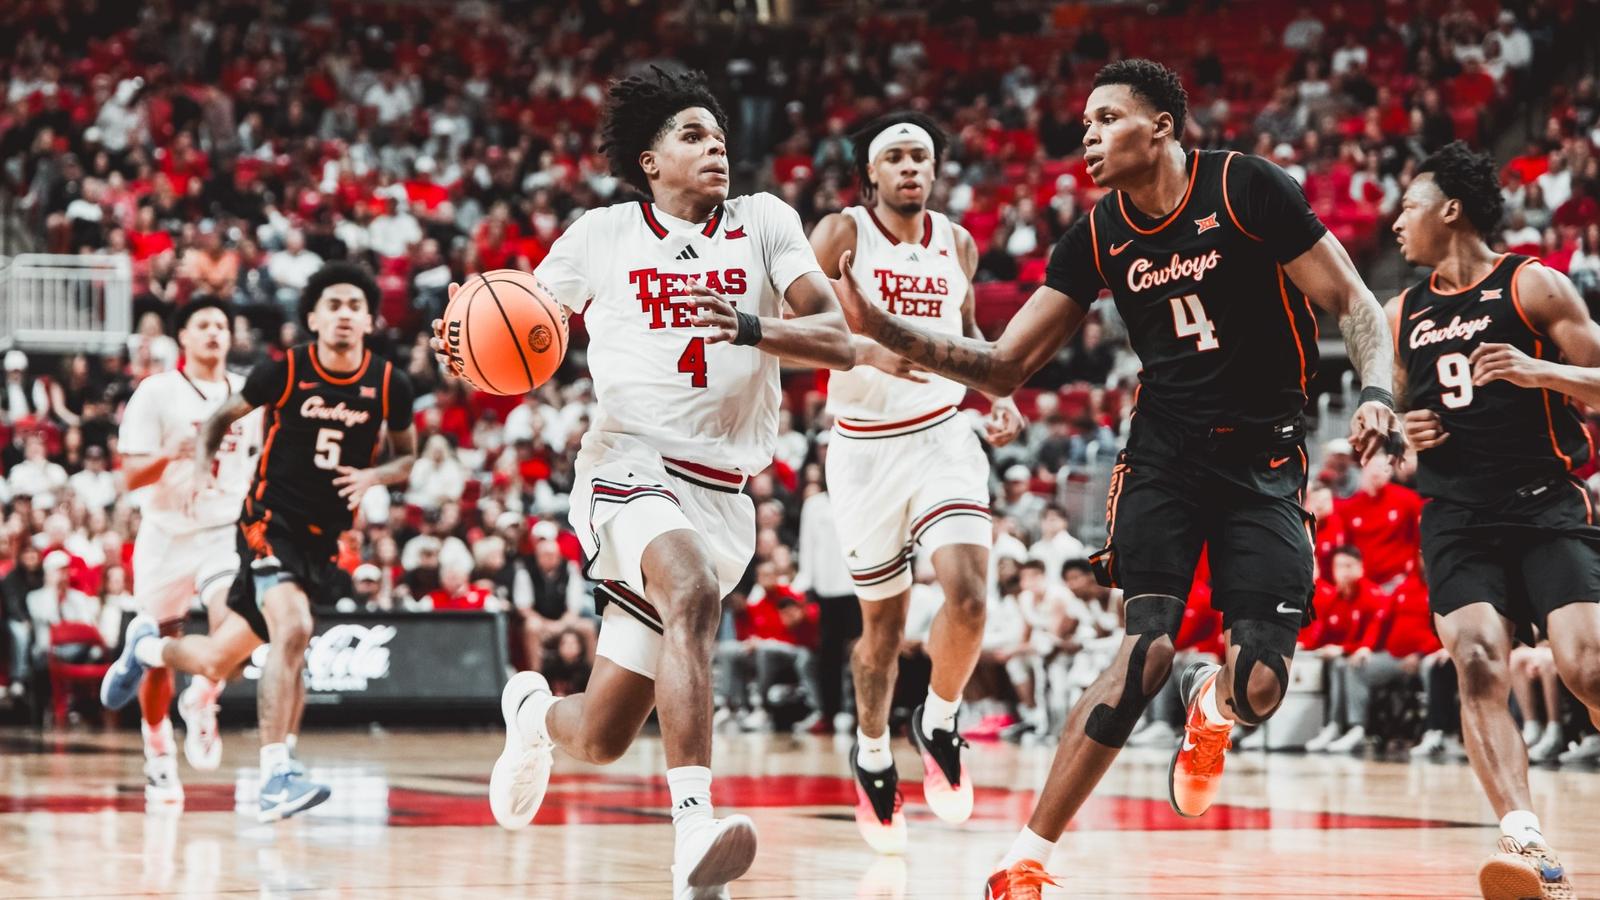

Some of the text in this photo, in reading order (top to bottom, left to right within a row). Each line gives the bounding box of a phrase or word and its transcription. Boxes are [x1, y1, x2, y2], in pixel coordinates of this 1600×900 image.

[873, 269, 948, 295] TEXAS
[1127, 250, 1222, 293] Cowboys
[880, 290, 942, 318] TECH
[1169, 294, 1220, 352] 4
[1409, 315, 1493, 349] Cowboys
[677, 336, 708, 388] 4
[1436, 352, 1474, 409] 9
[313, 427, 344, 470] 5
